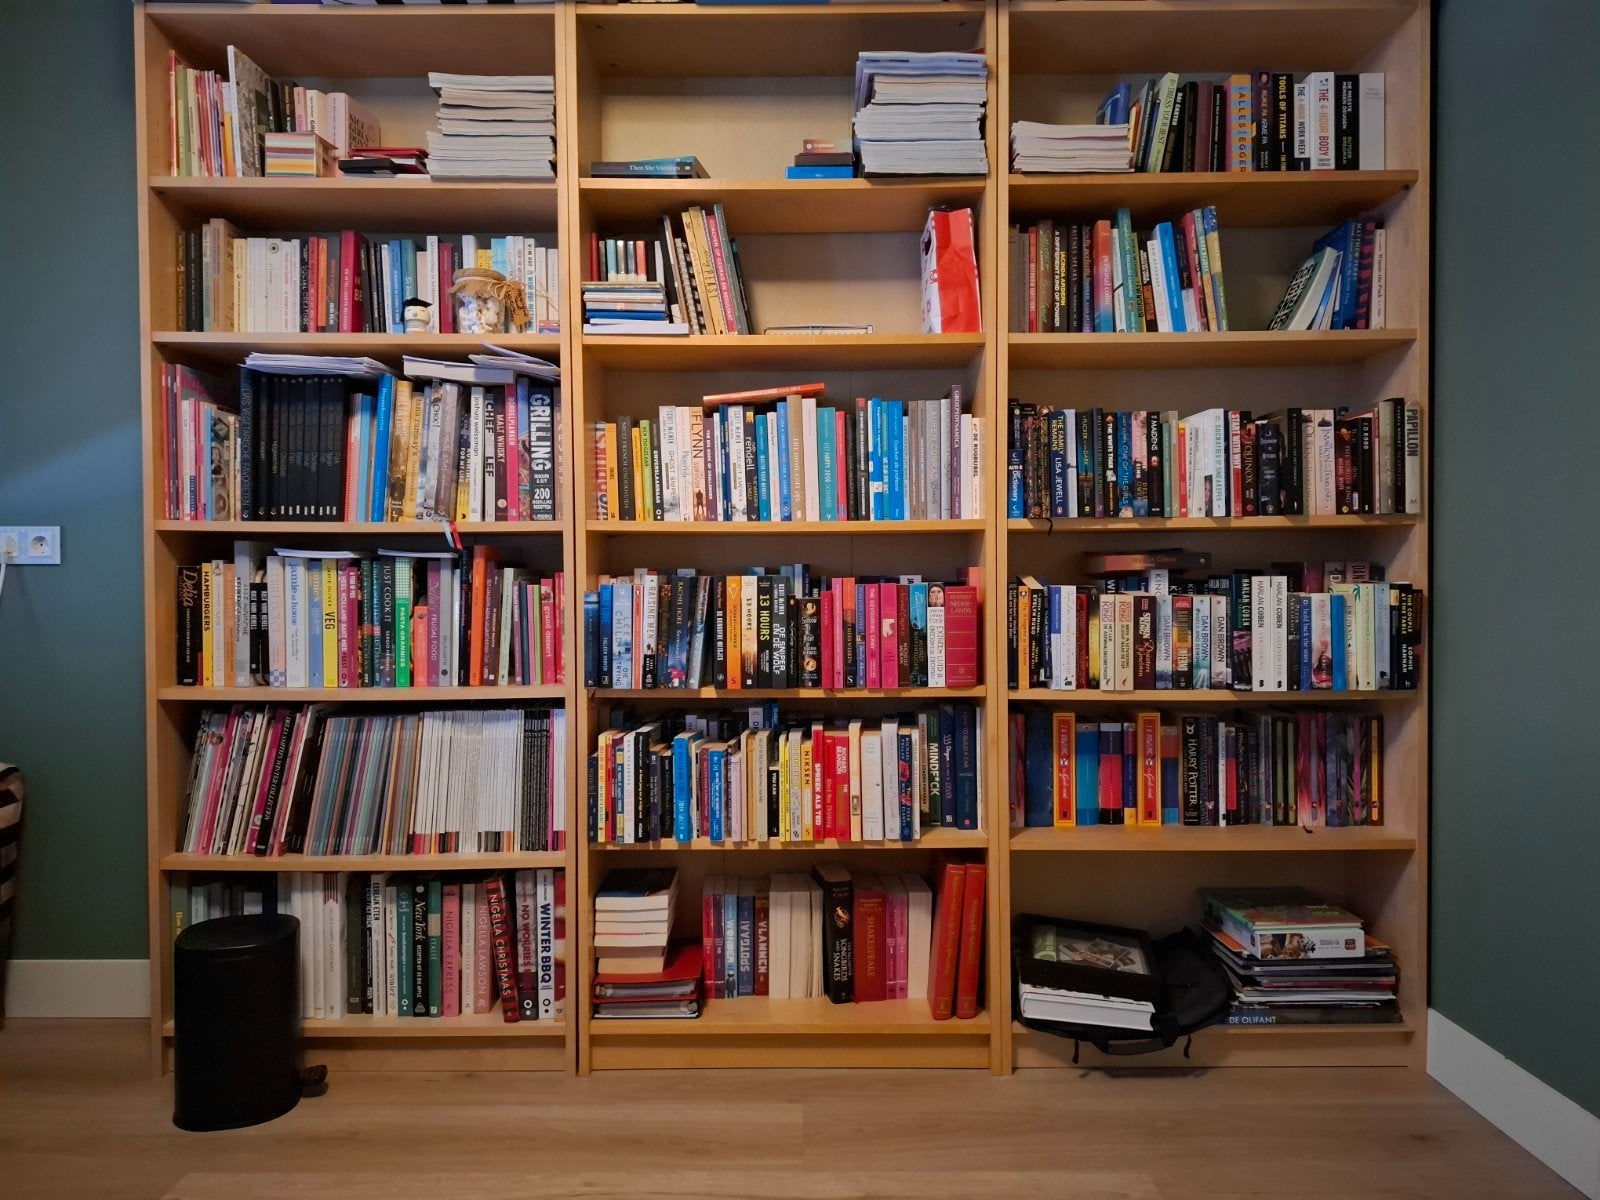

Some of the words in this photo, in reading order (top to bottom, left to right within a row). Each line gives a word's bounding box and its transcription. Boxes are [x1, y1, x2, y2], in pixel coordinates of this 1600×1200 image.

[1279, 102, 1286, 111] OF
[1319, 89, 1328, 102] THE
[1319, 104, 1328, 133] 4-HOUR
[1157, 128, 1166, 144] BEST
[1319, 136, 1328, 155] BODY
[709, 220, 718, 247] COACHEN
[716, 258, 725, 280] GEDRAG
[1102, 255, 1110, 285] personal
[721, 282, 726, 290] EN
[1055, 292, 1059, 301] OF
[723, 292, 732, 320] RESULTAAT
[411, 419, 420, 456] ramsay's
[530, 394, 551, 470] GRILLING
[692, 415, 703, 458] FLYNN
[1232, 414, 1240, 435] START
[1407, 409, 1418, 456] PAPILLON
[745, 437, 754, 470] rendell
[1232, 437, 1241, 454] WITH
[1233, 456, 1241, 468] WHY
[1244, 442, 1253, 484] EQUINOX
[534, 488, 550, 499] 200
[183, 570, 198, 607] Delia
[289, 563, 299, 593] jamie
[746, 598, 752, 606] 13
[760, 595, 769, 606] 13
[325, 612, 335, 629] VEG
[760, 611, 769, 640] HOURS
[773, 624, 779, 635] EN
[780, 628, 786, 638] DE
[773, 638, 779, 649] DE
[282, 716, 291, 735] DELIA
[1188, 739, 1197, 769] HARRY
[271, 760, 281, 784] WINTER
[264, 784, 277, 821] COLLECTION
[1189, 772, 1197, 806] POTTER
[415, 898, 425, 920] New
[489, 894, 502, 936] NIGELLA
[521, 905, 530, 920] NO
[415, 922, 425, 941] York
[479, 905, 488, 945] NIGELLA
[540, 903, 551, 954] WINTER
[522, 923, 531, 966] WORRIES
[741, 921, 750, 972] SPOTGAAI
[758, 921, 767, 973] VLAMMEN
[866, 916, 875, 977] SHAKESPEARE
[495, 939, 510, 996] CHRISTMAS
[540, 956, 551, 983] BBQ
